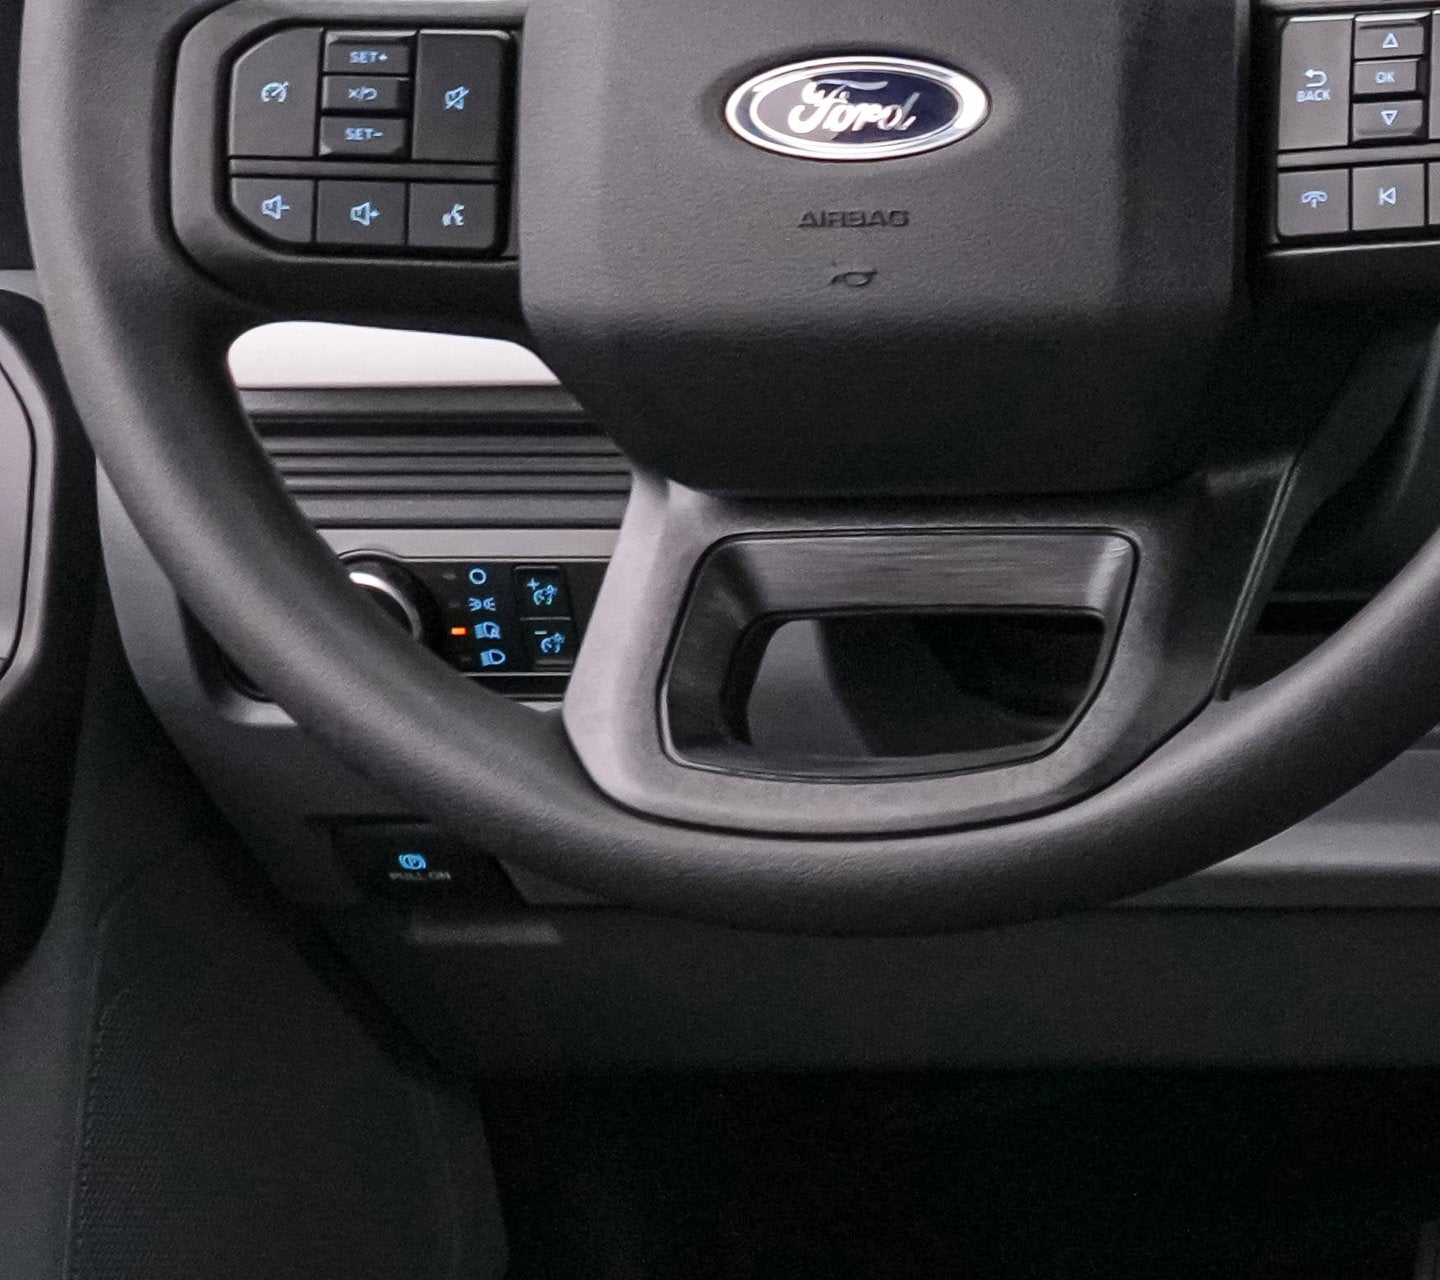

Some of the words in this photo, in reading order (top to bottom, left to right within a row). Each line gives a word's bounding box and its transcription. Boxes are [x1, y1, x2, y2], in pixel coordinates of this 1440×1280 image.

[1375, 71, 1395, 84] OK
[1296, 89, 1332, 102] BACK
[788, 78, 921, 133] Ford
[797, 210, 910, 228] AIRBAG
